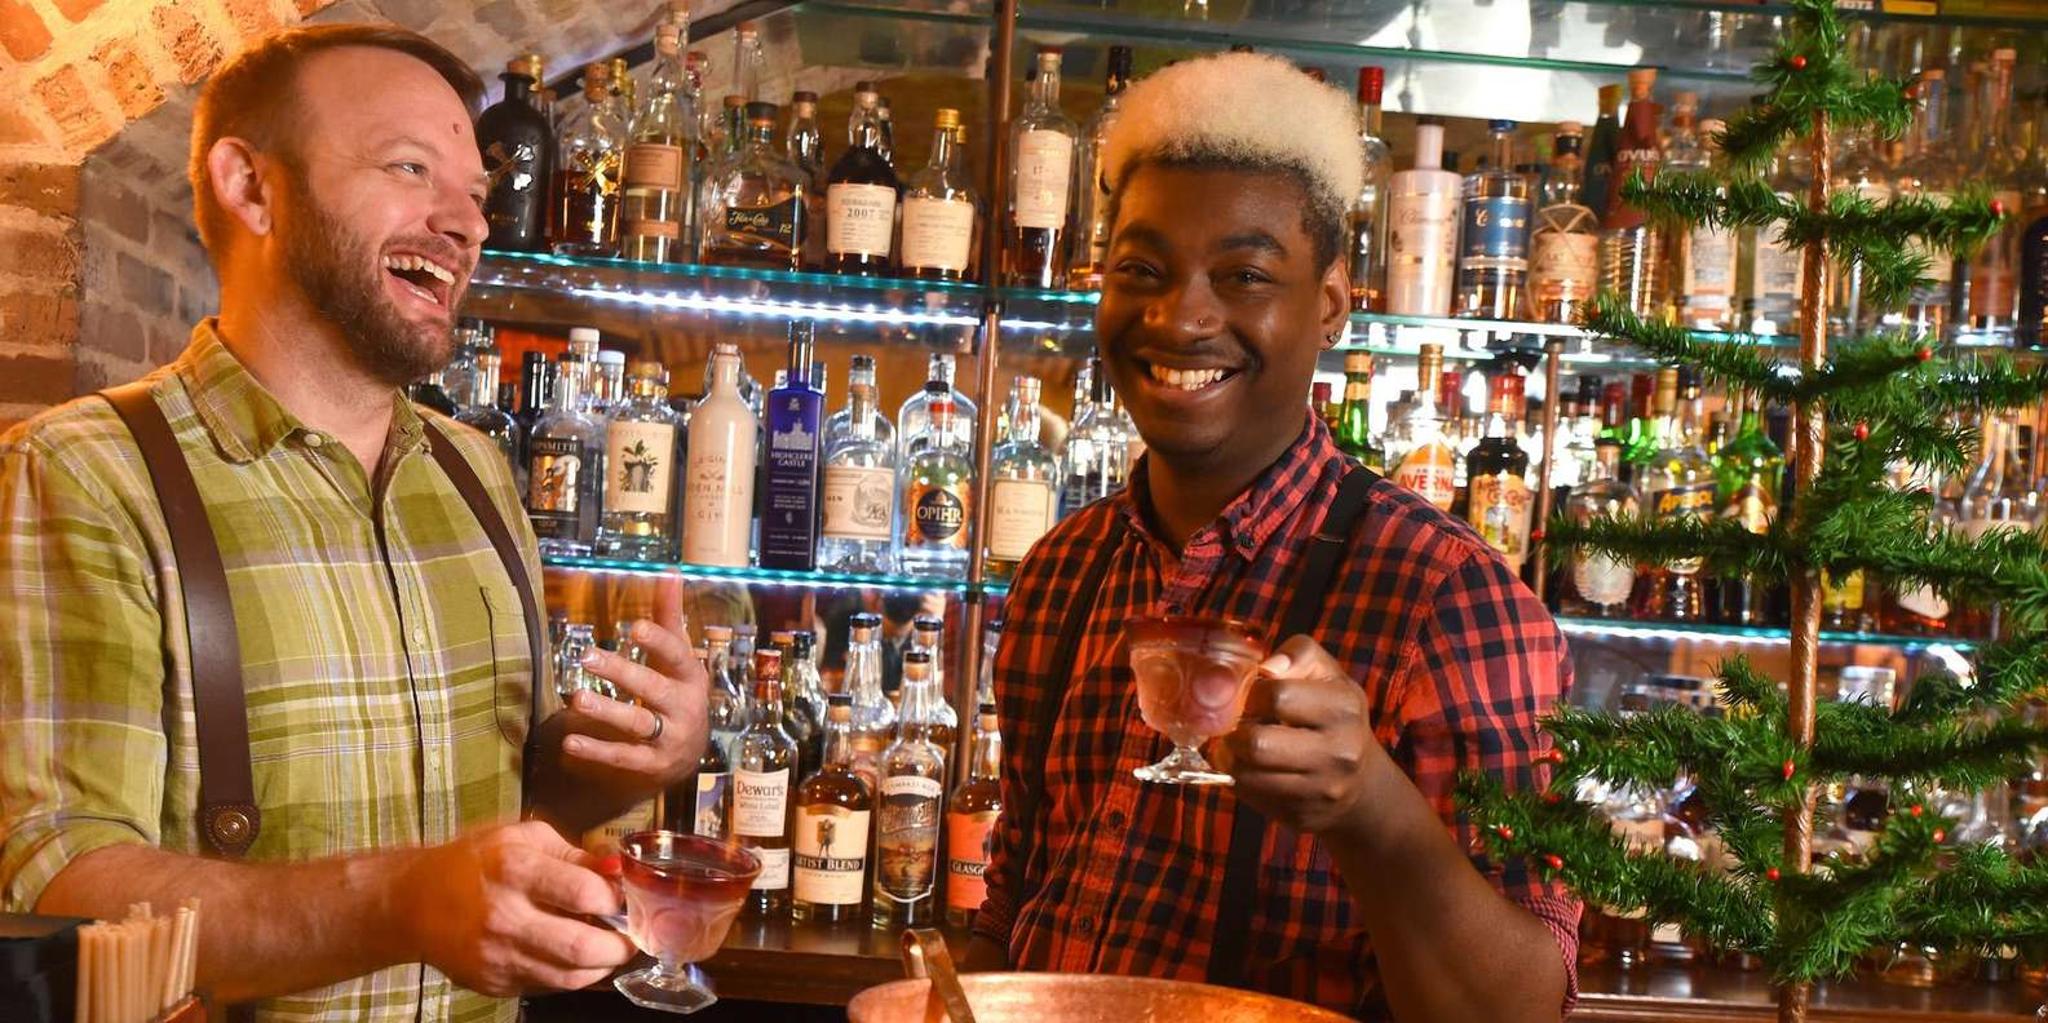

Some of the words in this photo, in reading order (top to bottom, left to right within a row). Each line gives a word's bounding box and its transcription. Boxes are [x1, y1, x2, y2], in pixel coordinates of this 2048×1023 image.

[847, 207, 876, 218] 2007
[917, 506, 962, 521] OPIHR
[827, 859, 861, 870] BLEND
